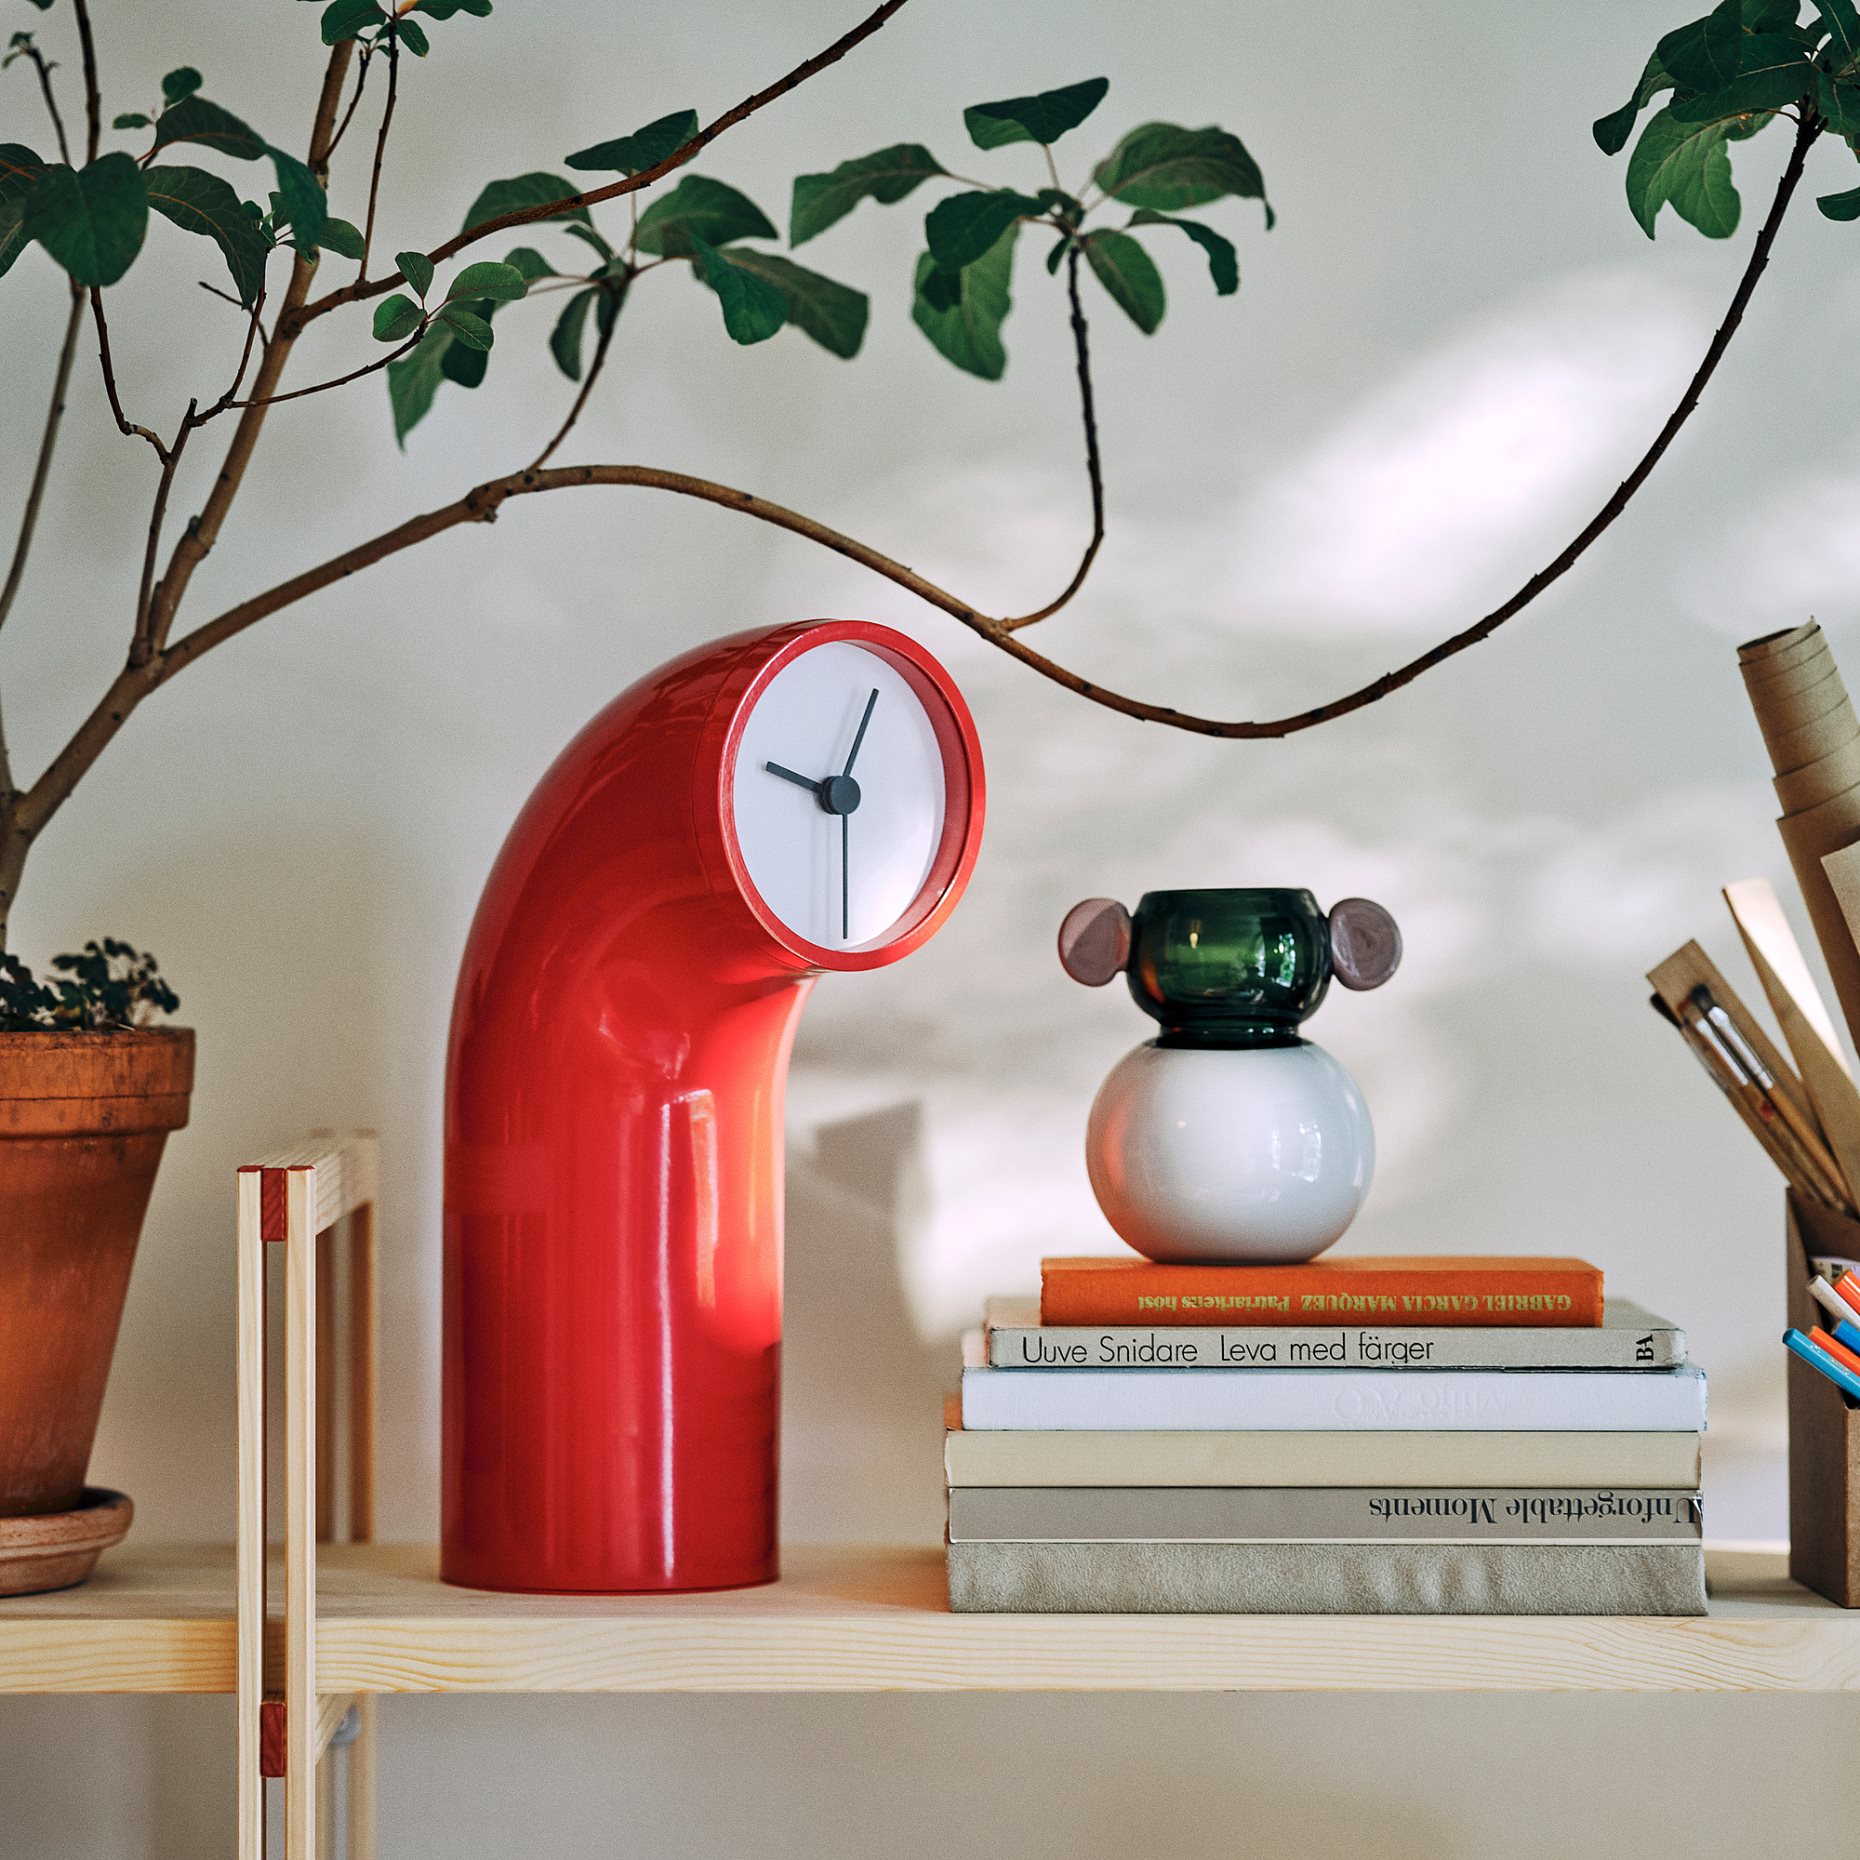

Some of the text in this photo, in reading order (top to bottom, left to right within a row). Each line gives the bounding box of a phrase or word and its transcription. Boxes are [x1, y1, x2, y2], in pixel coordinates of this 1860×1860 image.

[1137, 1296, 1178, 1312] höst
[1180, 1296, 1291, 1312] Patriarkens
[1482, 1295, 1572, 1311] GABRIEL
[1022, 1331, 1435, 1364] Uuve Snidare Leva med färger
[1368, 1491, 1698, 1525] Unforgettable Moments
